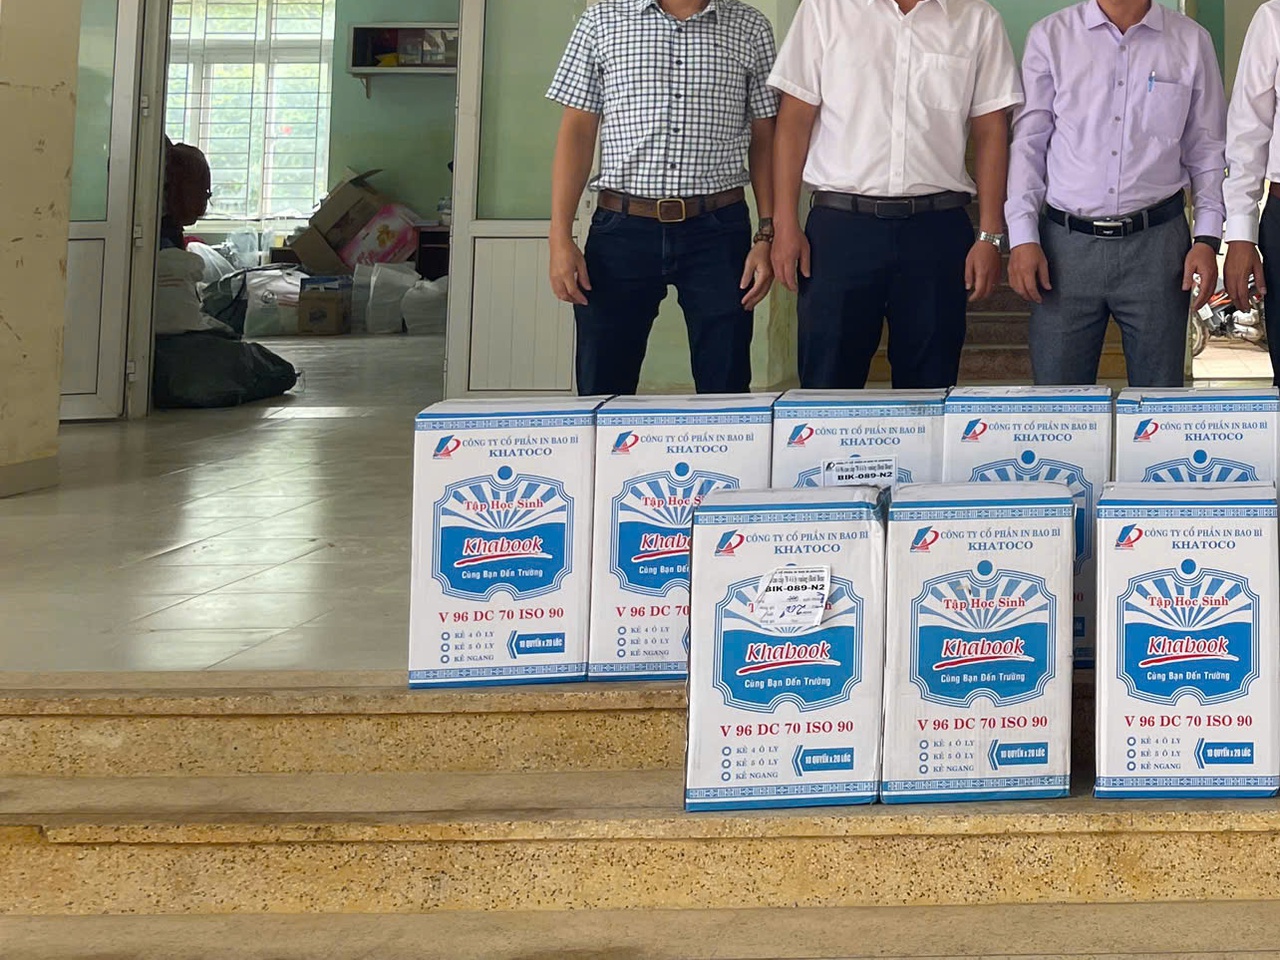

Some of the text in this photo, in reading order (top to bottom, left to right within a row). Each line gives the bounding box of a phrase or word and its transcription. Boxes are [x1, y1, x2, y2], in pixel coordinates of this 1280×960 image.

[1160, 422, 1181, 430] CÔNG
[1242, 422, 1258, 430] BAO
[462, 438, 485, 447] CÔNG
[540, 437, 548, 445] IN
[840, 437, 900, 446] KHATOCO
[1013, 433, 1072, 442] KHATOCO
[1185, 433, 1243, 441] KHATOCO
[489, 447, 552, 457] KHATOCO
[666, 445, 728, 454] KHATOCO
[838, 472, 893, 480] BIK-089-N2
[465, 499, 543, 512] Tập Học Sinh
[642, 496, 690, 508] Tập Học
[1145, 529, 1168, 537] CÔNG
[1171, 529, 1181, 537] TY
[1223, 529, 1232, 537] IN
[1235, 529, 1252, 537] BAO
[463, 536, 543, 555] Khabook
[774, 544, 840, 555] KHATOCO
[968, 541, 1033, 551] KHATOCO
[1172, 540, 1236, 549] KHATOCO
[462, 568, 543, 580] Cùng Bạn Đến Trường
[765, 584, 825, 592] BIK-089-N2
[943, 597, 1025, 610] Tập Học Sinh
[1148, 596, 1228, 608] Tập Học Sinh
[438, 608, 565, 623] V 96 DC 70 ISO 90
[942, 637, 1025, 657] Khabook
[1148, 636, 1229, 654] Khabook
[746, 641, 831, 662] Khabook
[941, 672, 1025, 684] Cùng Bạn Đến Trường
[1124, 715, 1252, 727] V 96 DC 70 ISO 90
[720, 720, 853, 737] V 96 DC 70 ISO 90
